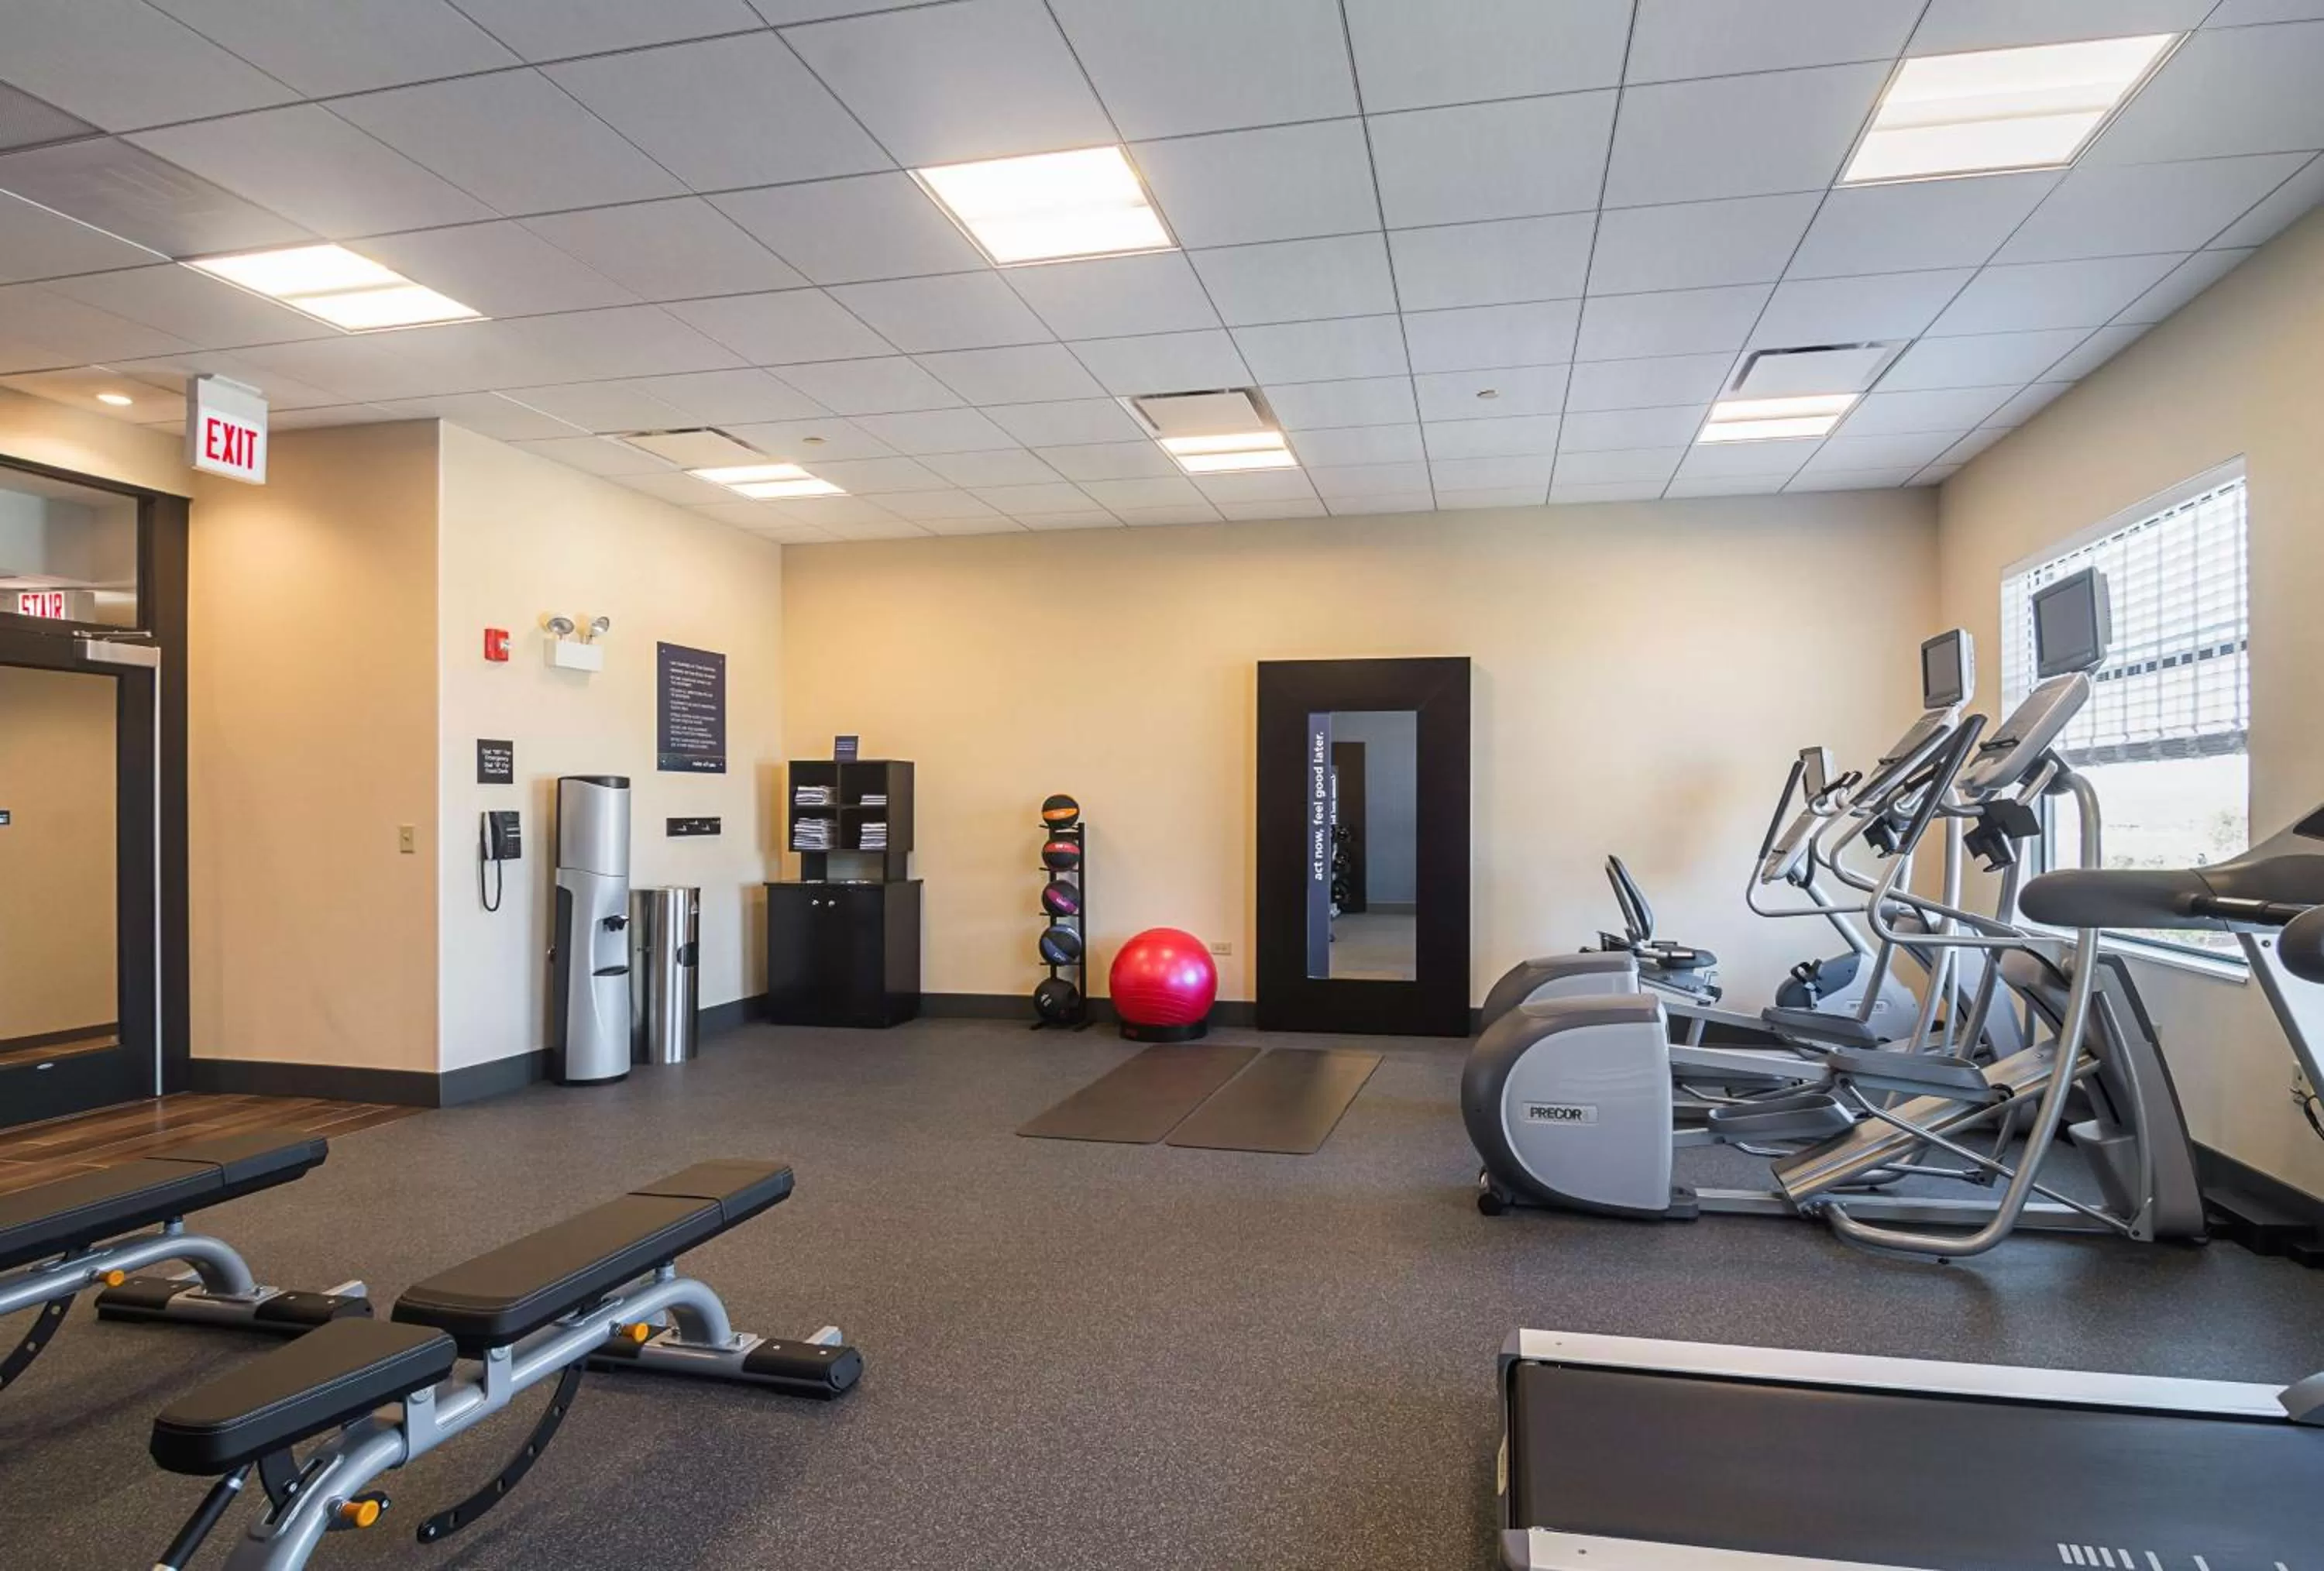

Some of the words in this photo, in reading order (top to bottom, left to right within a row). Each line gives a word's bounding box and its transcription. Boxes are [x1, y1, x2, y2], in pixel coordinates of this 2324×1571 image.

[206, 417, 258, 469] EXIT
[22, 593, 62, 620] STAIR
[1313, 731, 1324, 763] later.
[1313, 766, 1326, 799] good
[1313, 802, 1324, 825] feel
[1315, 829, 1325, 859] now,
[1313, 861, 1323, 881] act
[1530, 1107, 1582, 1120] PRECOR
